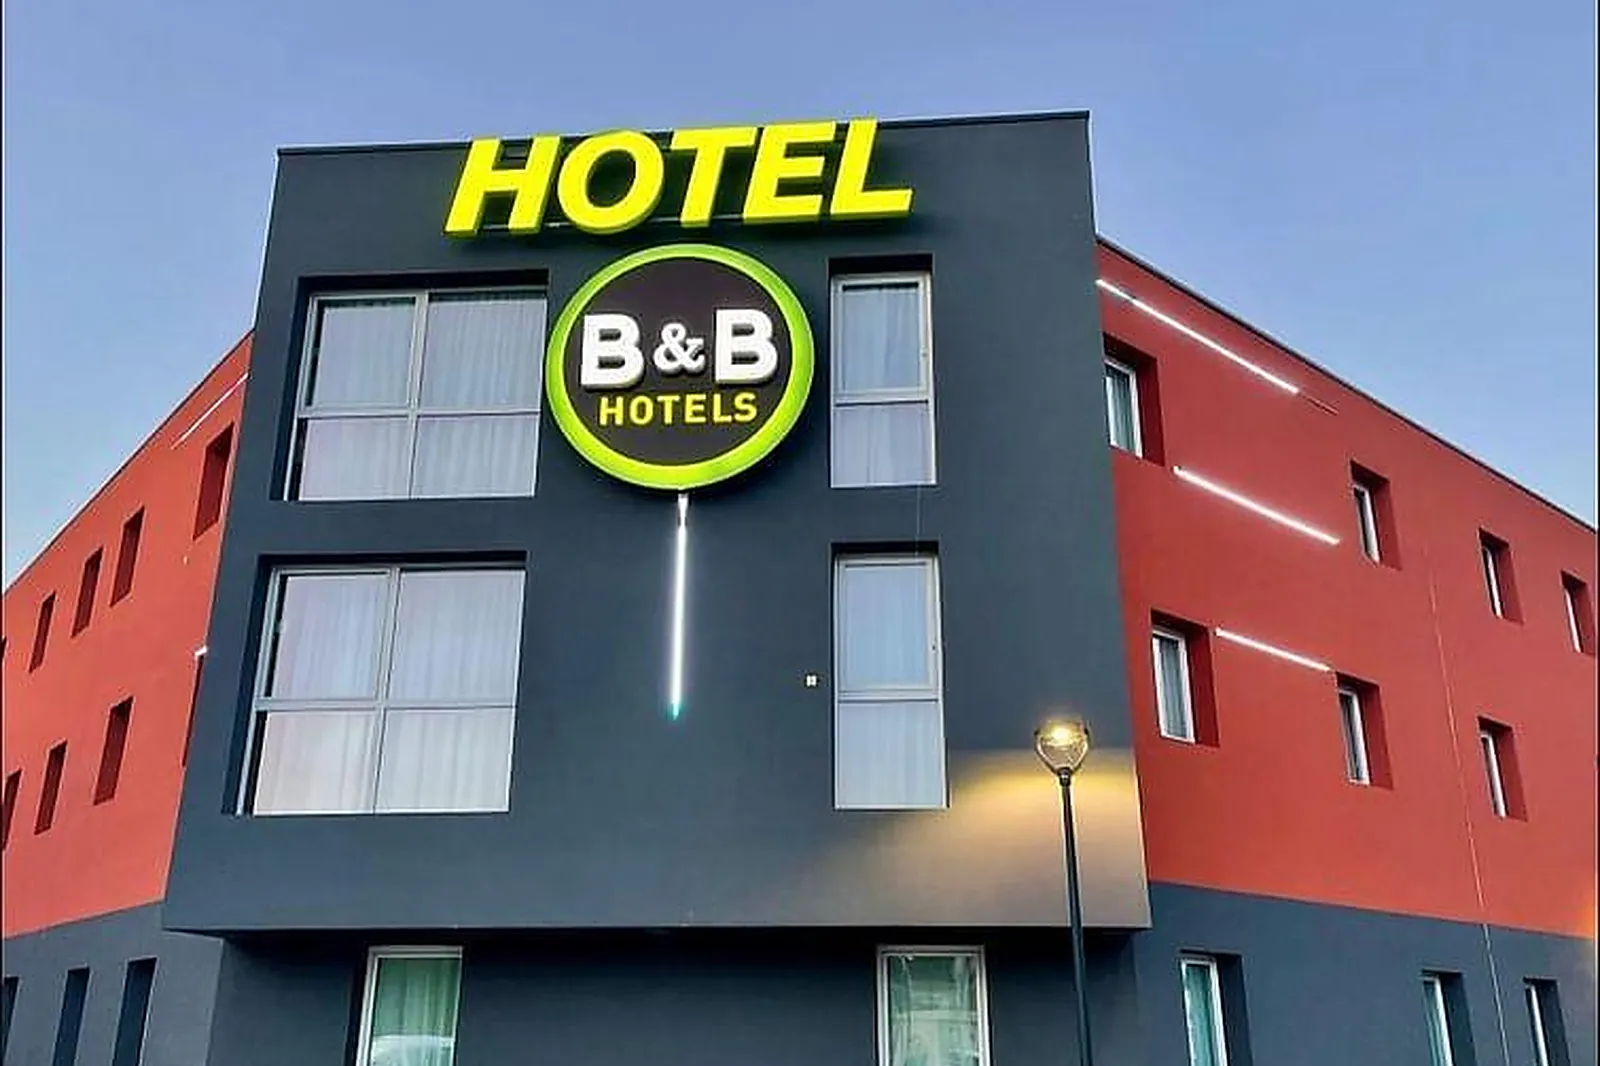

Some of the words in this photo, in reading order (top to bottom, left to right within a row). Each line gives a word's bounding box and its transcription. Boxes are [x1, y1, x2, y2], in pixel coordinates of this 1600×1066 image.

[443, 118, 914, 238] HOTEL
[579, 308, 778, 390] B&B
[598, 392, 758, 426] HOTELS
